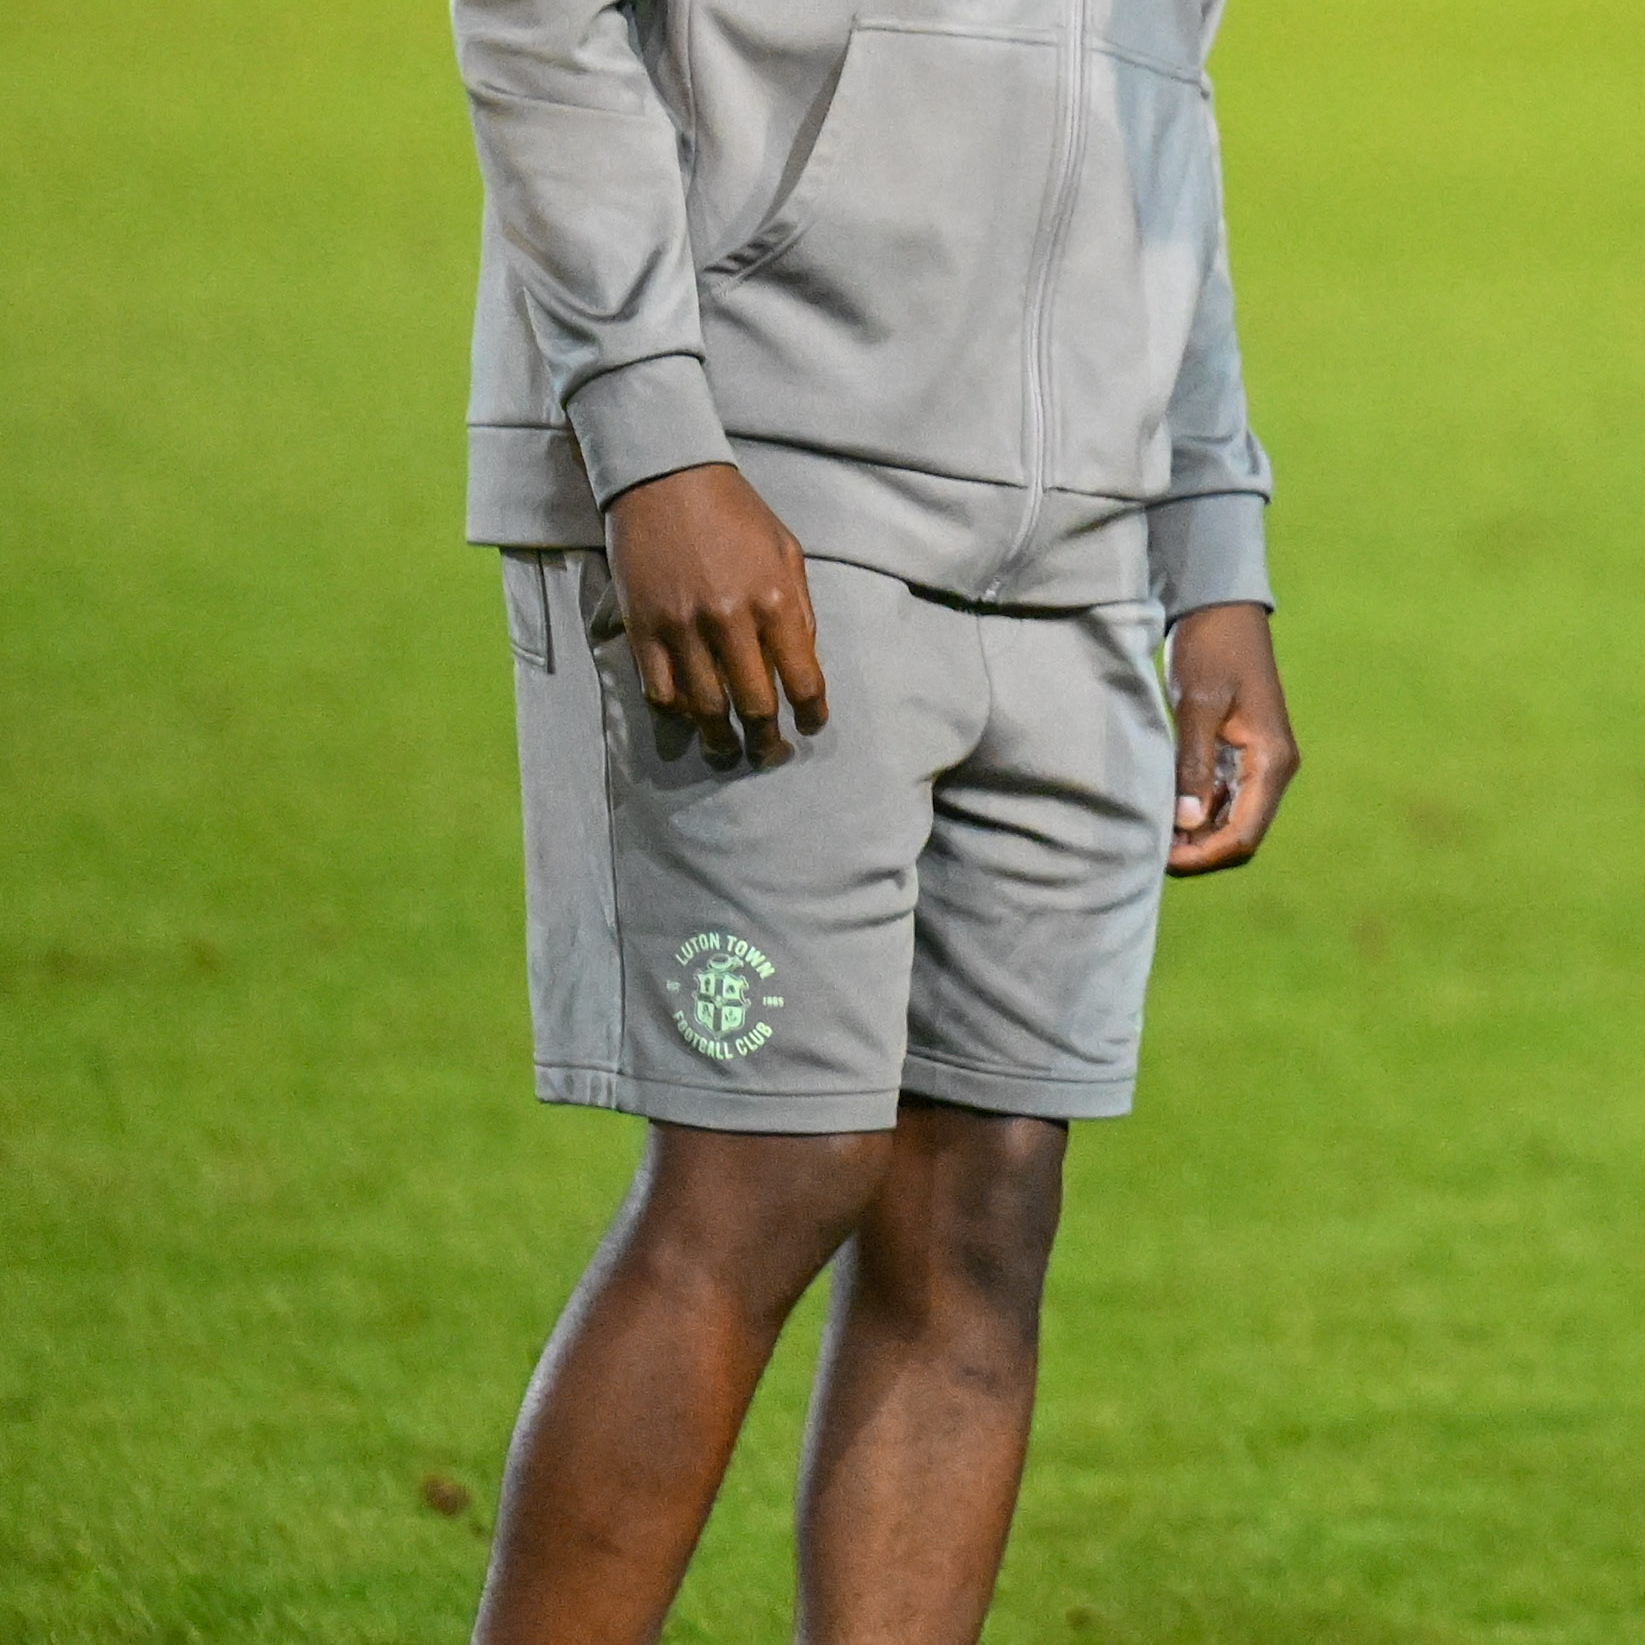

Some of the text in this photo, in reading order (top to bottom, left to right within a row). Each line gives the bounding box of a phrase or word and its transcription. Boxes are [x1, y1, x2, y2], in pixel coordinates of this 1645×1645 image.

[675, 932, 775, 979] LUTON TOWN
[673, 1010, 773, 1060] FOOTBALL CLUB
